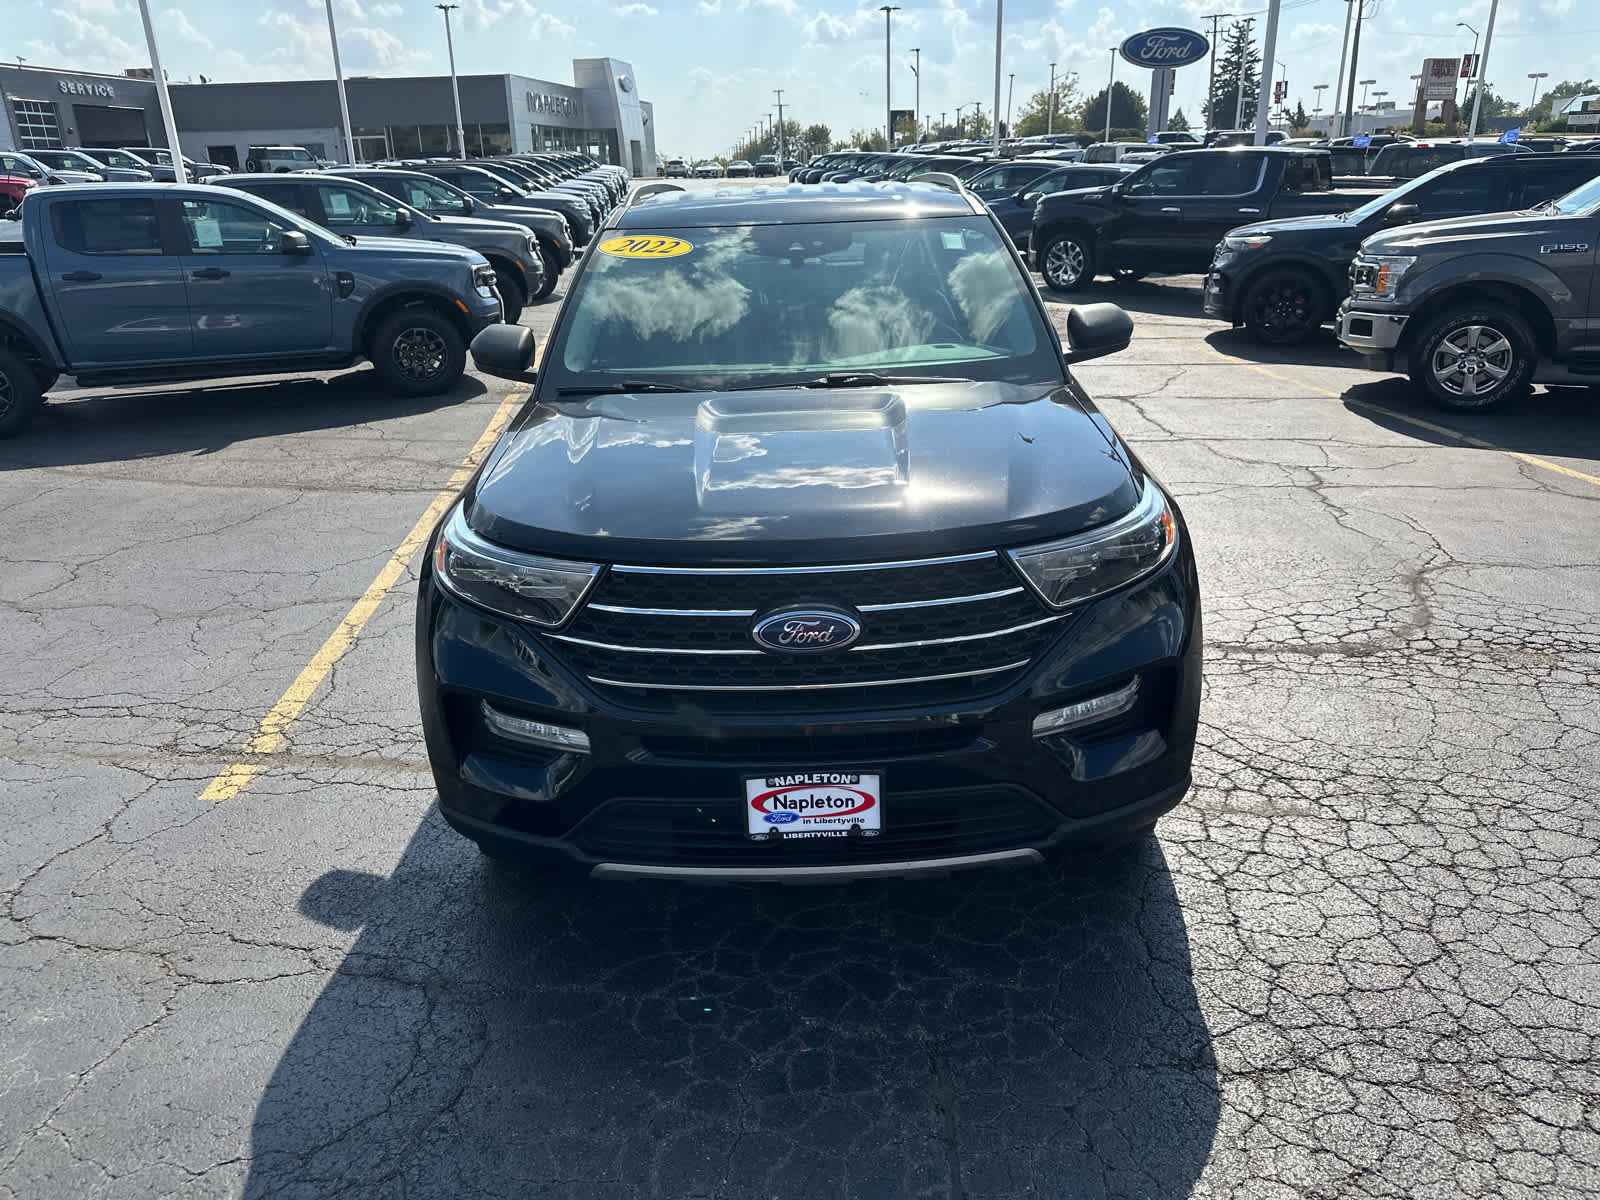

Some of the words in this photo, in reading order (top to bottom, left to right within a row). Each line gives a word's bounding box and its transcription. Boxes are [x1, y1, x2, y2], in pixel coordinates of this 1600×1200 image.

[1140, 35, 1193, 59] Ford
[58, 80, 115, 97] SERVICE
[526, 91, 578, 117] NAPLETON
[612, 239, 681, 254] 2022
[778, 620, 835, 644] Ford
[774, 773, 852, 786] NAPLETON
[773, 794, 856, 813] Napleton
[770, 813, 793, 823] Ford
[814, 816, 865, 824] Libertyville
[783, 831, 848, 839] LIBERTYVILLE
